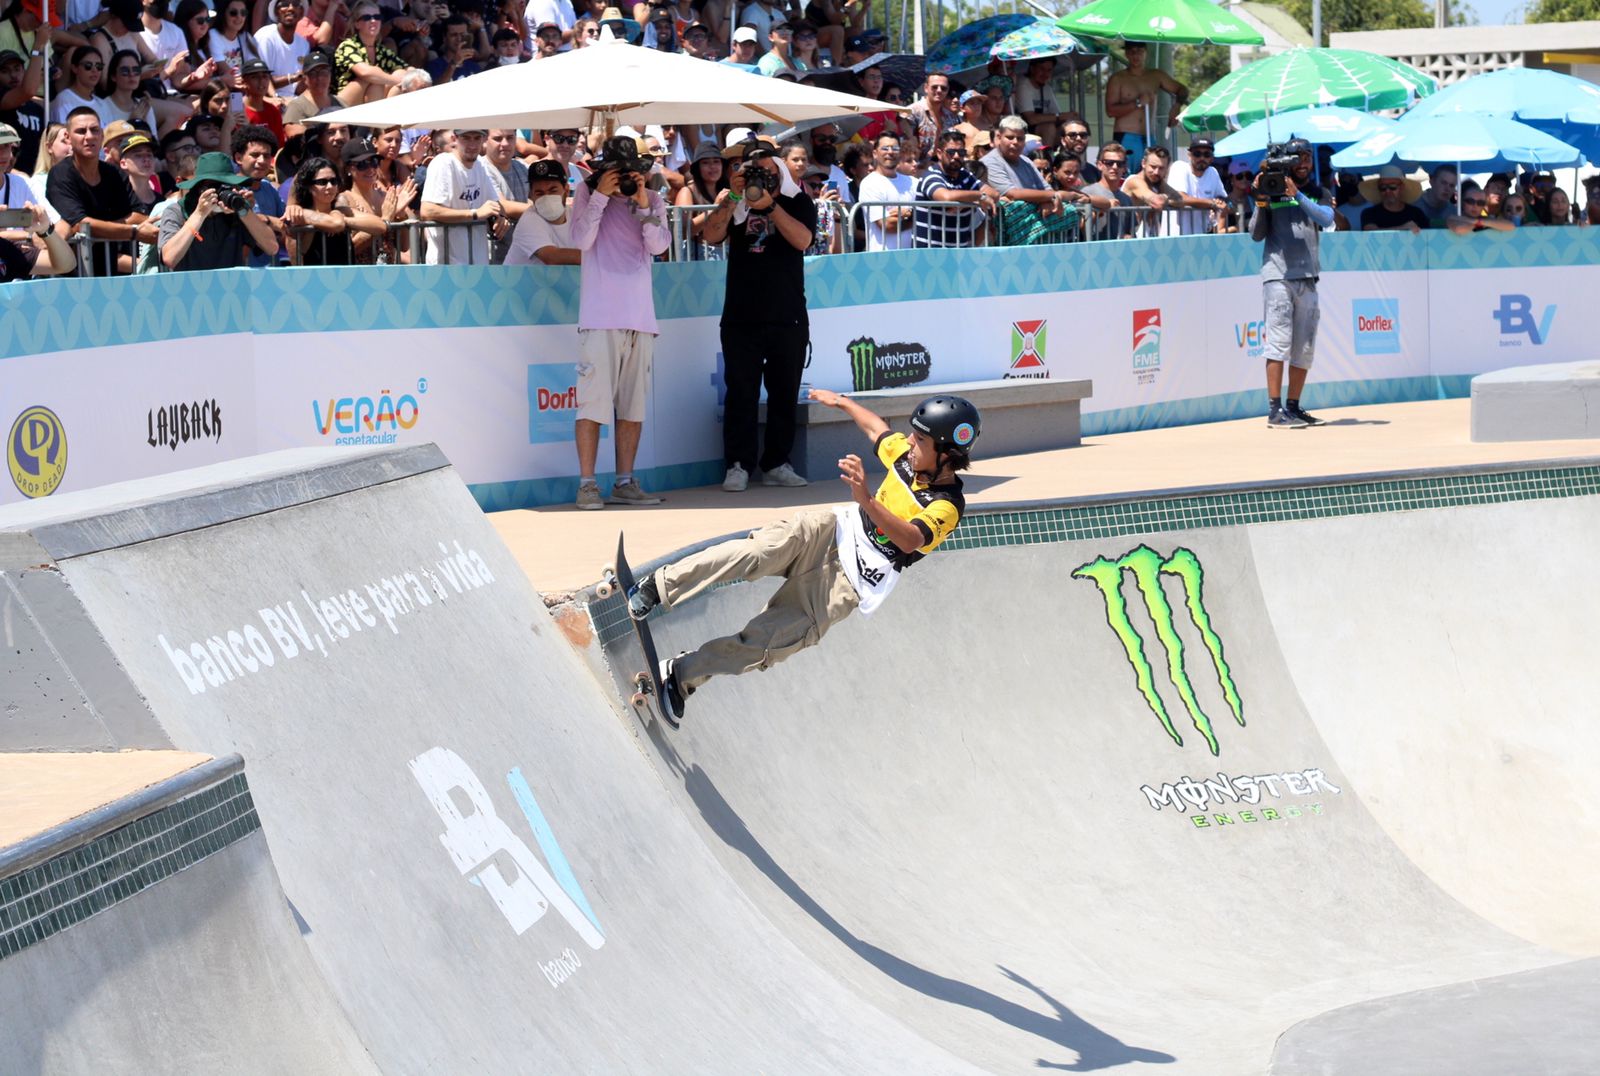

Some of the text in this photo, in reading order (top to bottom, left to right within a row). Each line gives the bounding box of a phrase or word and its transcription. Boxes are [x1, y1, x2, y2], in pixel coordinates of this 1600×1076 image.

[1358, 315, 1393, 331] Dorflex
[1499, 339, 1522, 347] banco
[876, 351, 927, 369] MONSTER
[1134, 352, 1159, 367] FME
[884, 369, 919, 379] ENERGY
[147, 398, 222, 451] LAYBACK
[312, 389, 419, 435] VERÃO
[16, 463, 62, 492] DROP DEAD
[158, 624, 274, 695] banco
[301, 590, 377, 642] leve
[436, 540, 496, 594] vida
[1140, 767, 1341, 813] MONSTER
[1190, 802, 1322, 828] ENERGY
[537, 947, 582, 989] banco
